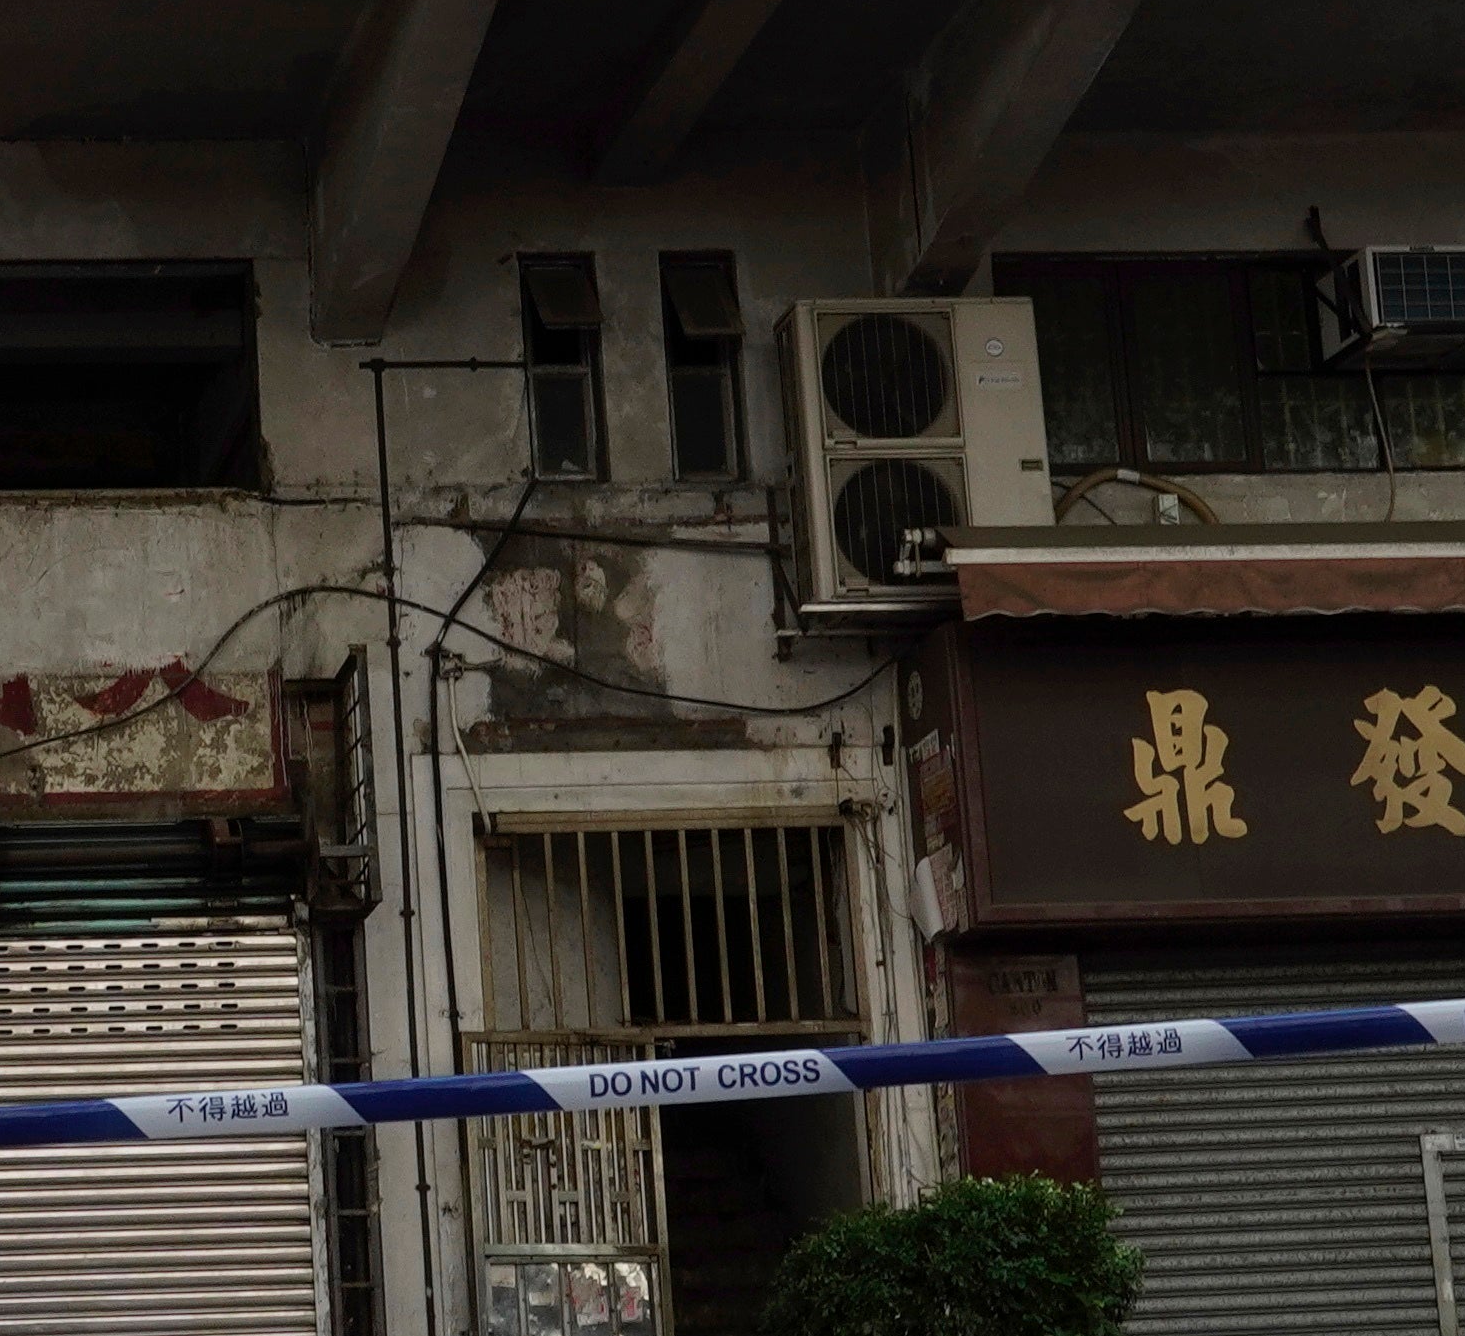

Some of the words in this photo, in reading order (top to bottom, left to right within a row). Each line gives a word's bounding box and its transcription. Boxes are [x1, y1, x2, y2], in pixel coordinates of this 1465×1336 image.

[1067, 1028, 1184, 1060] 不得越過
[589, 1071, 634, 1099] DO
[640, 1066, 701, 1096] NOT
[717, 1059, 821, 1091] CROSS
[166, 1093, 290, 1123] 不得越過
